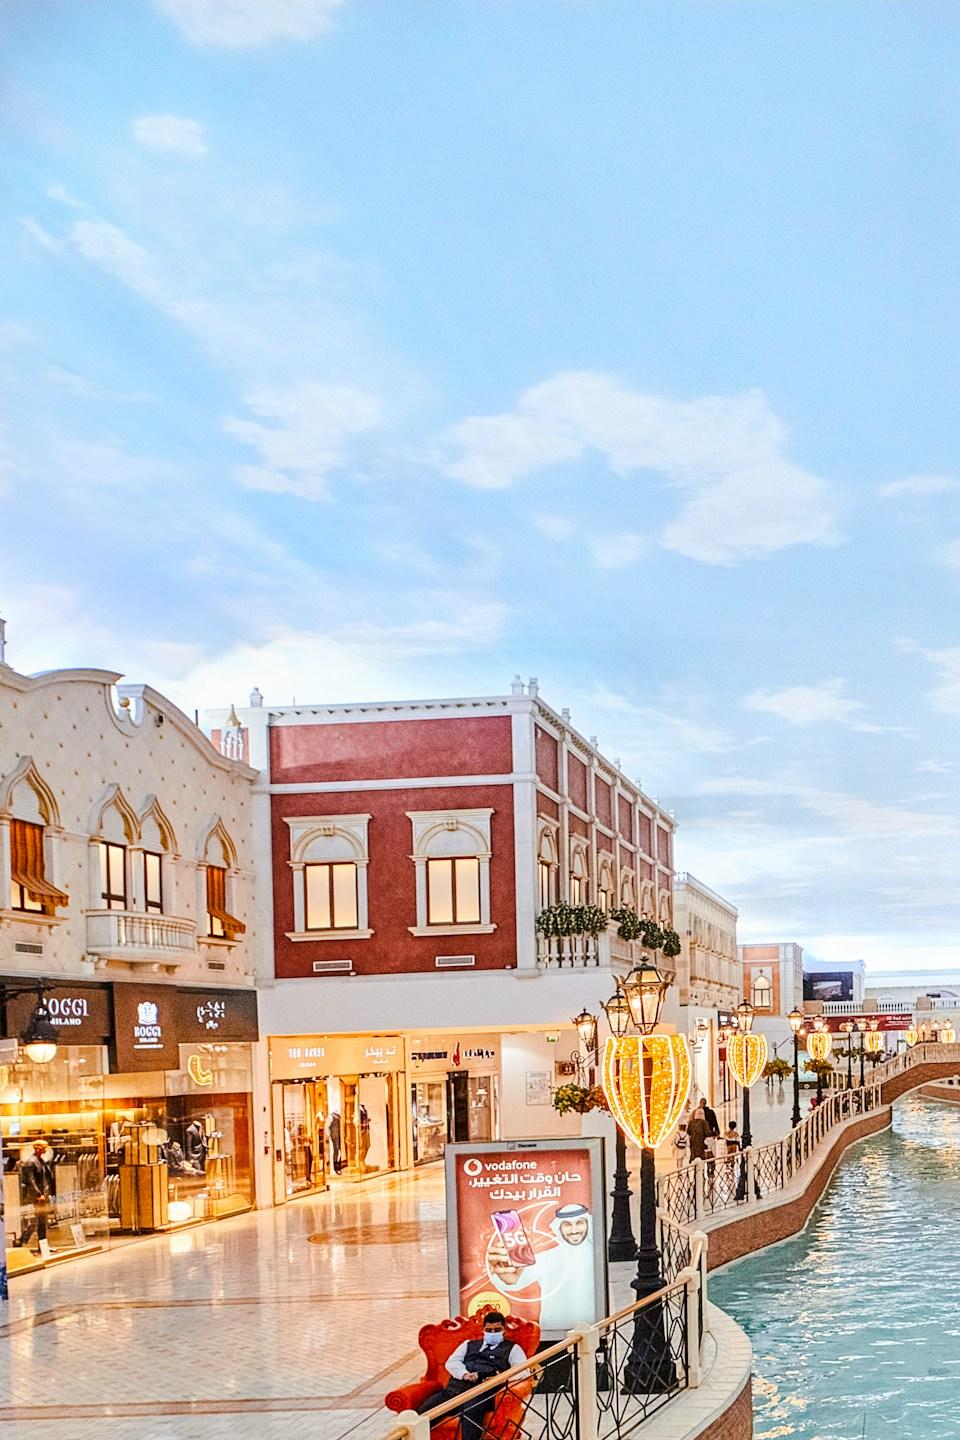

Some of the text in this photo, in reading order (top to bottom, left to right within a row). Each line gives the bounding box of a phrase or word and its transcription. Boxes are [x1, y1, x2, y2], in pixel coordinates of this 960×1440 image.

[484, 1160, 537, 1171] vodafone
[520, 1172, 552, 1184] وقت
[554, 1171, 582, 1184] حان
[489, 1186, 561, 1201] القرار بيدك
[504, 1231, 527, 1247] 5G
